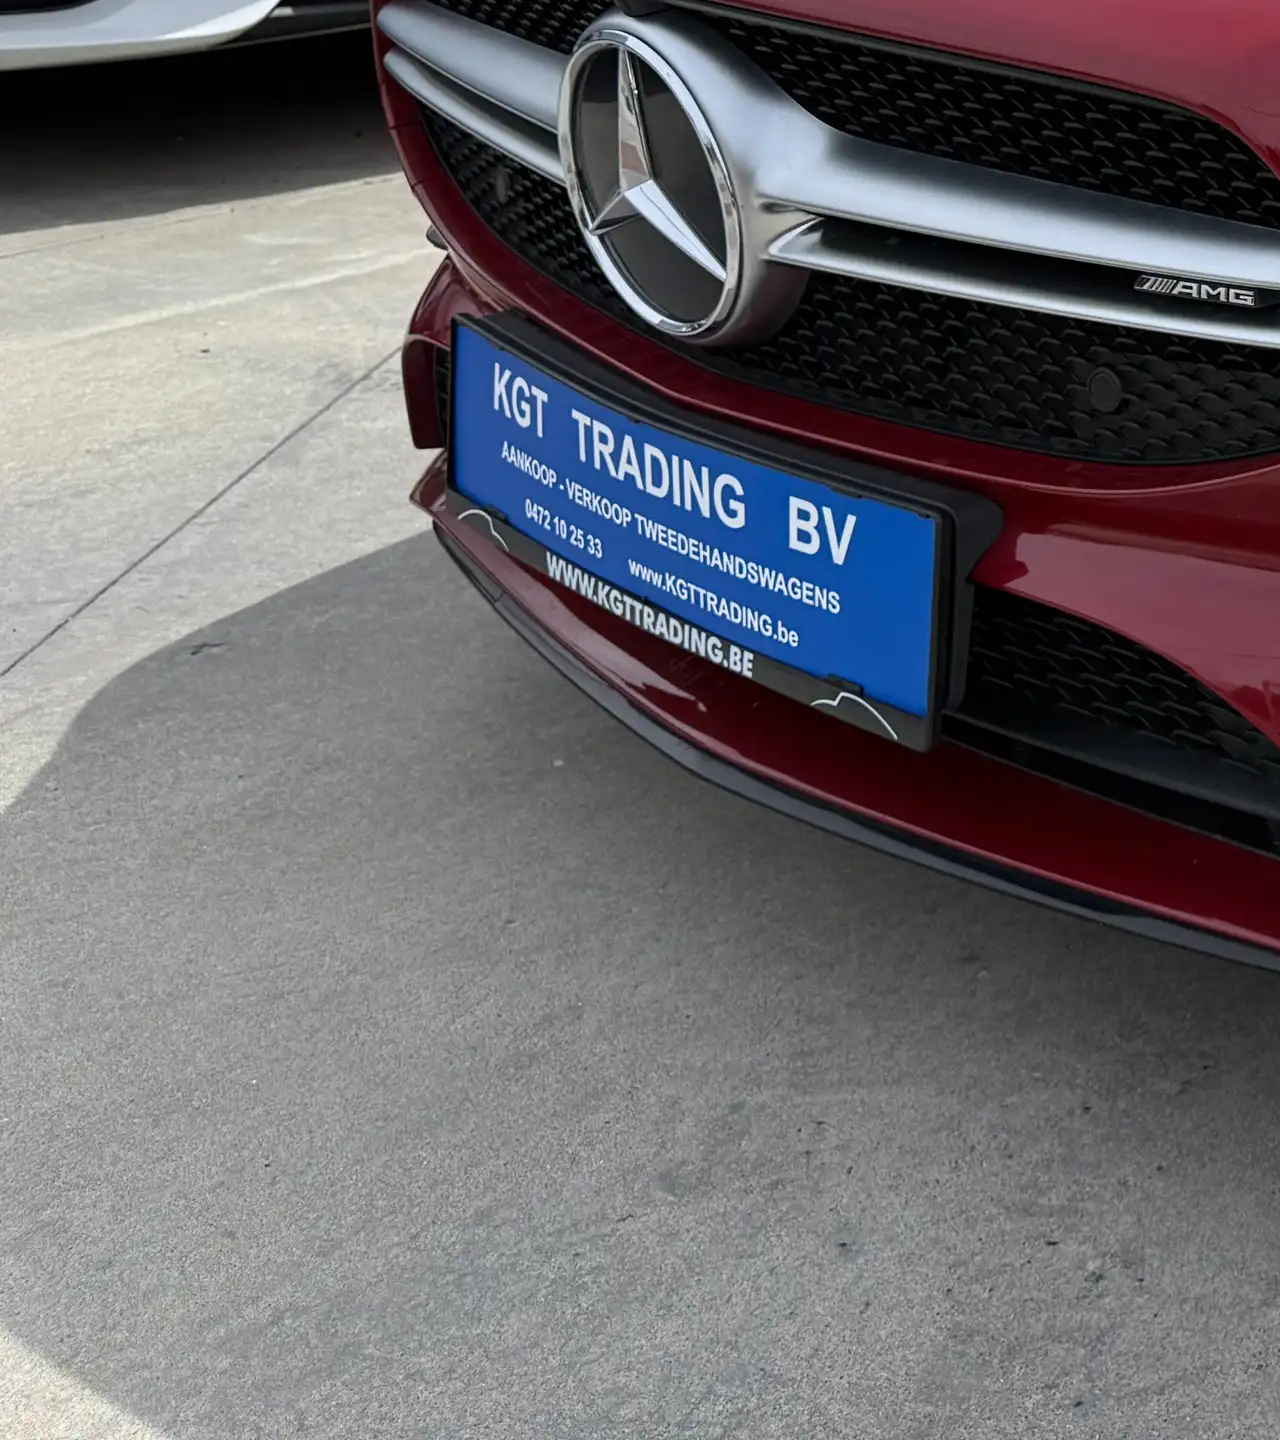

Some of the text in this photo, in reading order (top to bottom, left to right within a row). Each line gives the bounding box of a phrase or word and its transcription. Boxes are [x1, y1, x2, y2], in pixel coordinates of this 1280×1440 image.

[1170, 280, 1255, 306] AMG
[493, 362, 857, 566] KGT TRADING BV
[501, 441, 557, 488] AANKOOP
[567, 478, 632, 528] VERKOOP
[634, 513, 840, 614] TWEEDEHANDSWAGENS
[525, 499, 603, 558] 0472 10 25 33
[546, 551, 754, 678] WWW.KGTTRADING.BE
[628, 559, 799, 648] www.KGTTRADING.be
